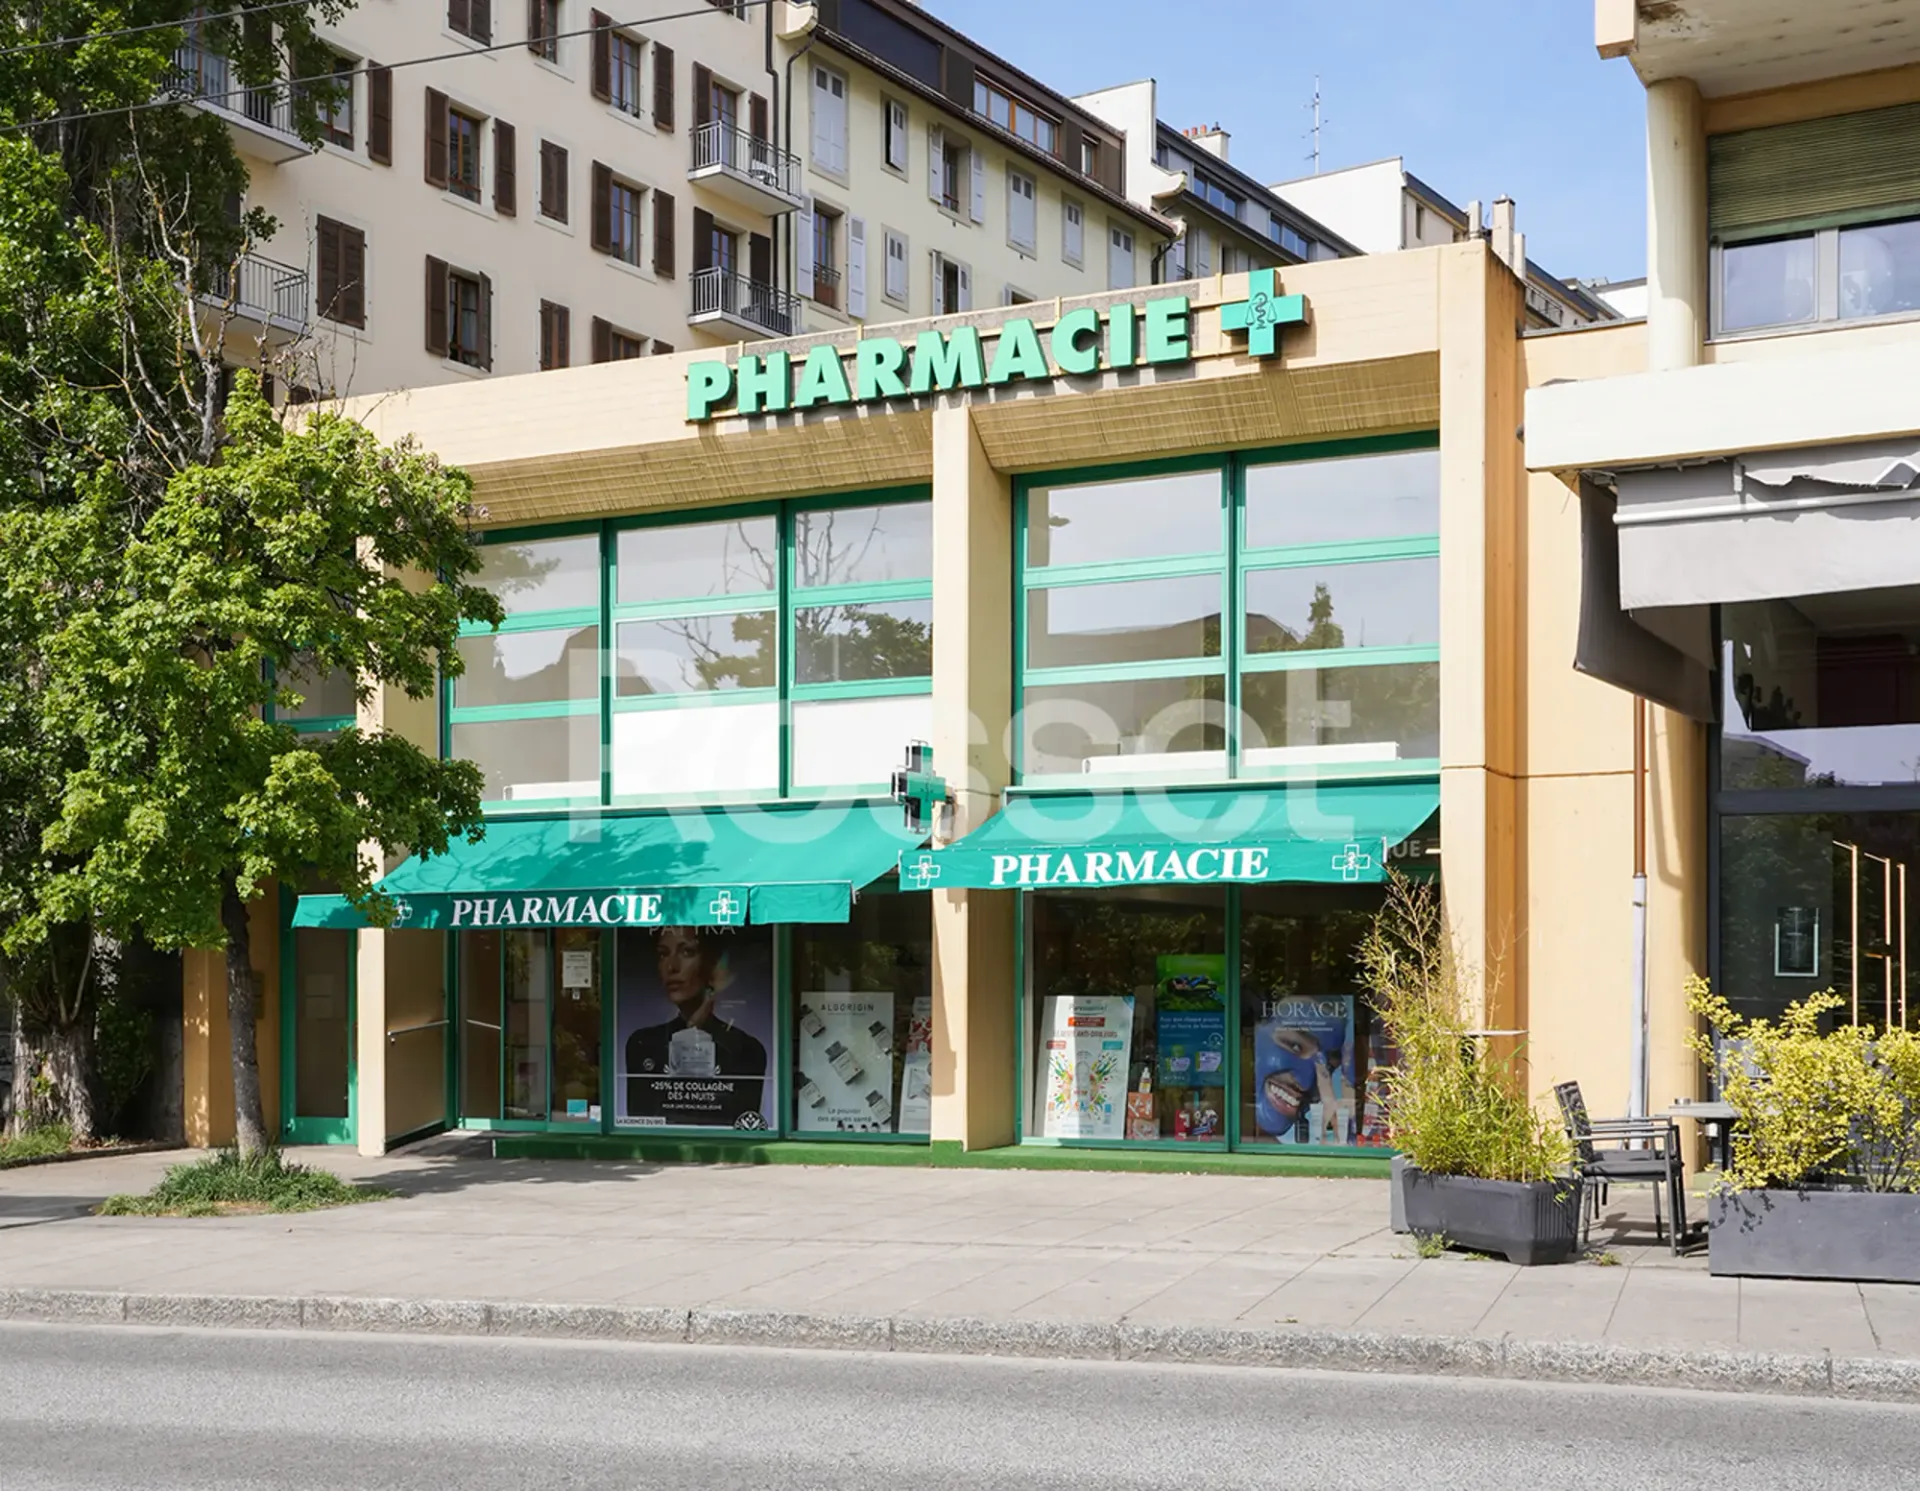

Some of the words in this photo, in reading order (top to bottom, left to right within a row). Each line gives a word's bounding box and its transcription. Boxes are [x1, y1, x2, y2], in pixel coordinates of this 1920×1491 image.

[687, 296, 1190, 421] PHARMACIE
[1388, 840, 1421, 858] UE
[990, 848, 1269, 885] PHARMACIE
[450, 894, 662, 926] PHARMACIE
[820, 1003, 874, 1012] ALGORIGIN
[1260, 1001, 1348, 1017] HORACE
